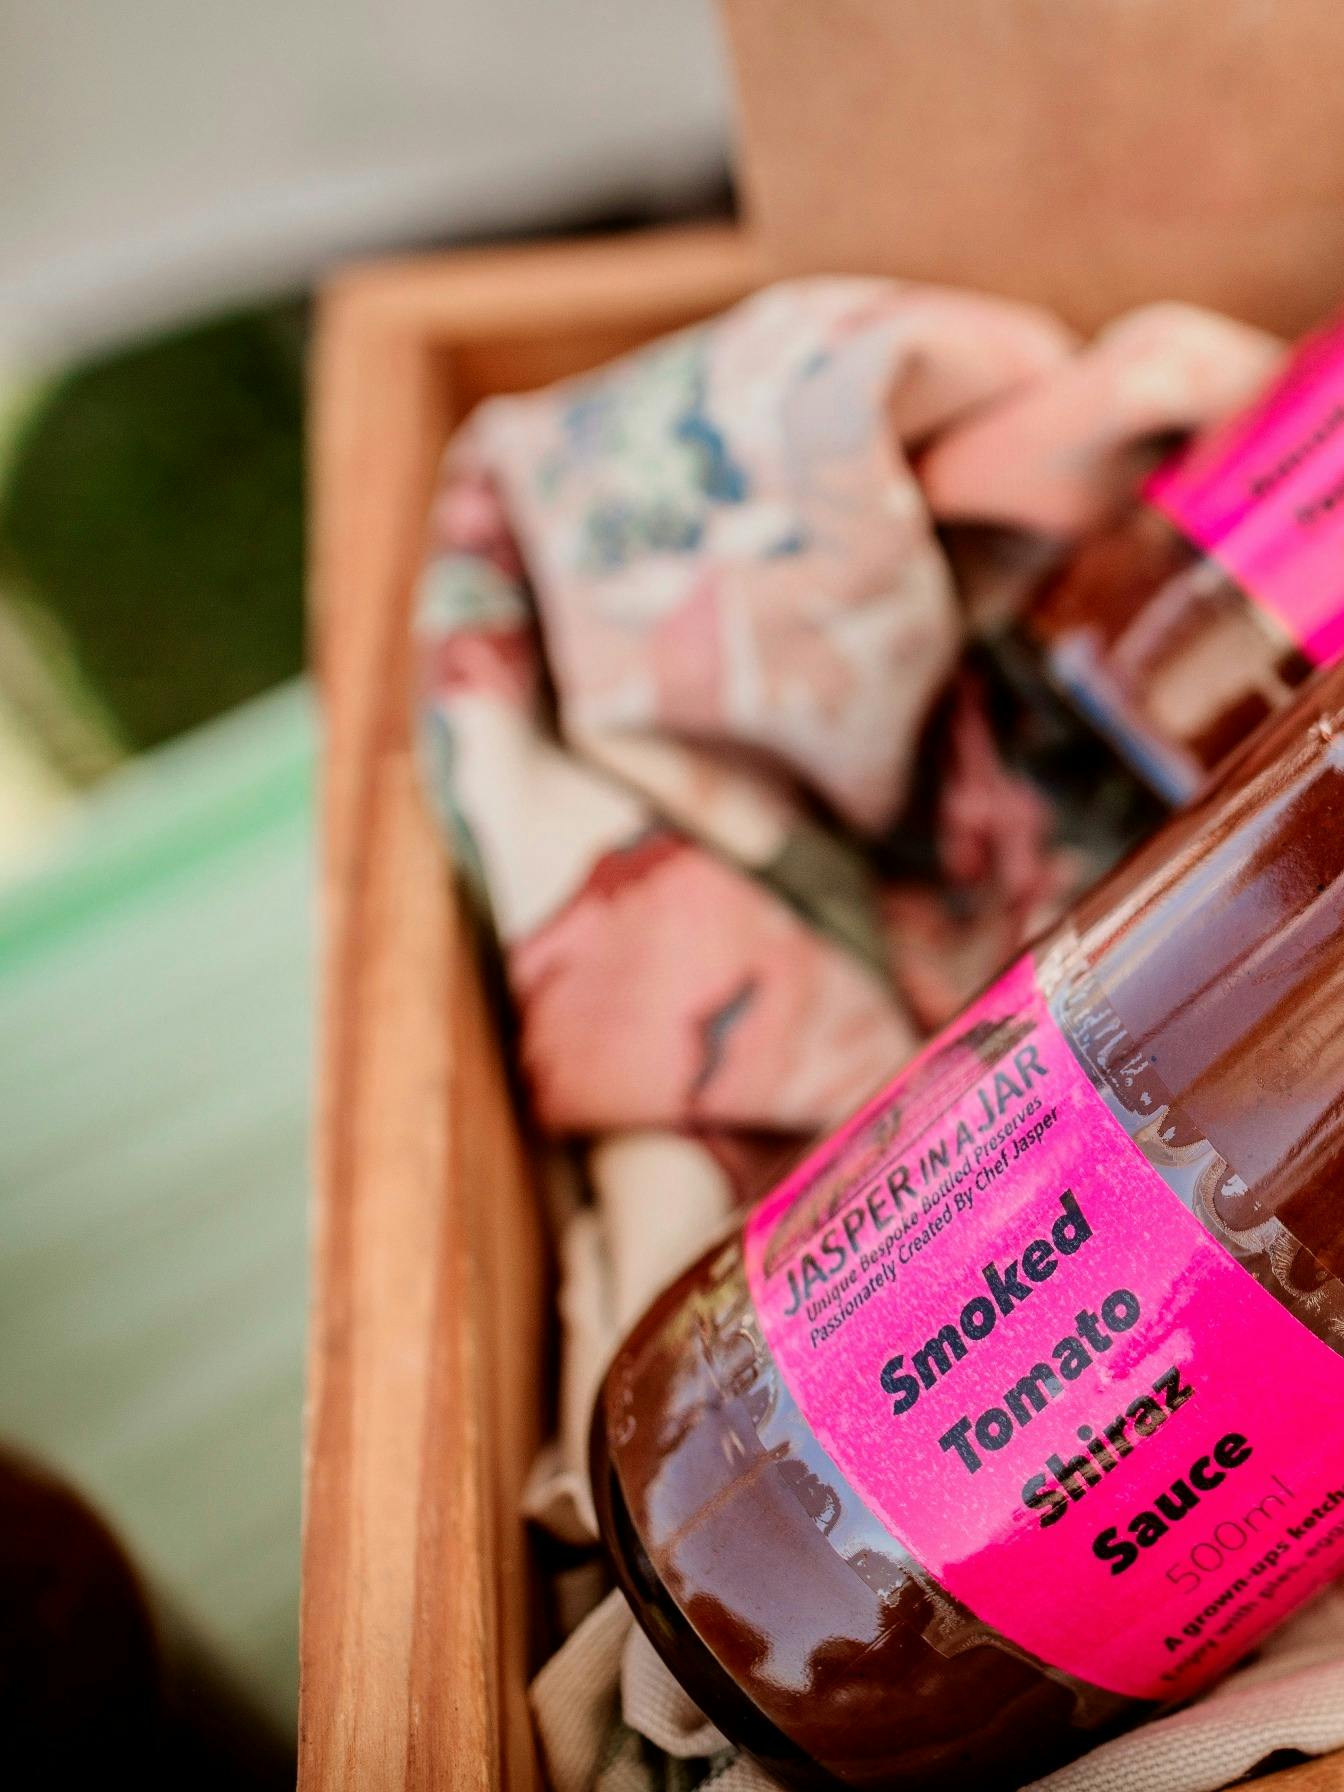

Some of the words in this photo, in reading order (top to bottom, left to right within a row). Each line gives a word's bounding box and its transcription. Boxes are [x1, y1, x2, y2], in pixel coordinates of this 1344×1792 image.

[784, 1165, 918, 1316] JASPER
[920, 1140, 949, 1187] IN
[956, 1121, 974, 1156] A
[978, 1045, 1049, 1134] JAR
[806, 1271, 857, 1323] Unique
[860, 1212, 919, 1274] Bespoke
[922, 1158, 972, 1214] Bottled
[975, 1096, 1043, 1160] Preserves
[809, 1261, 897, 1349] Passionately
[898, 1211, 953, 1265] Created
[953, 1187, 974, 1213] By
[974, 1151, 1010, 1191] Chef
[1010, 1106, 1060, 1160] Jasper
[879, 1188, 1094, 1415] Smoked
[938, 1289, 1141, 1475] Tomato
[1021, 1365, 1196, 1528] Shiraz
[1092, 1432, 1253, 1576] Sauce
[1166, 1474, 1295, 1594] 500ml
[1164, 1636, 1183, 1652] A
[1183, 1540, 1291, 1638] grown-ups
